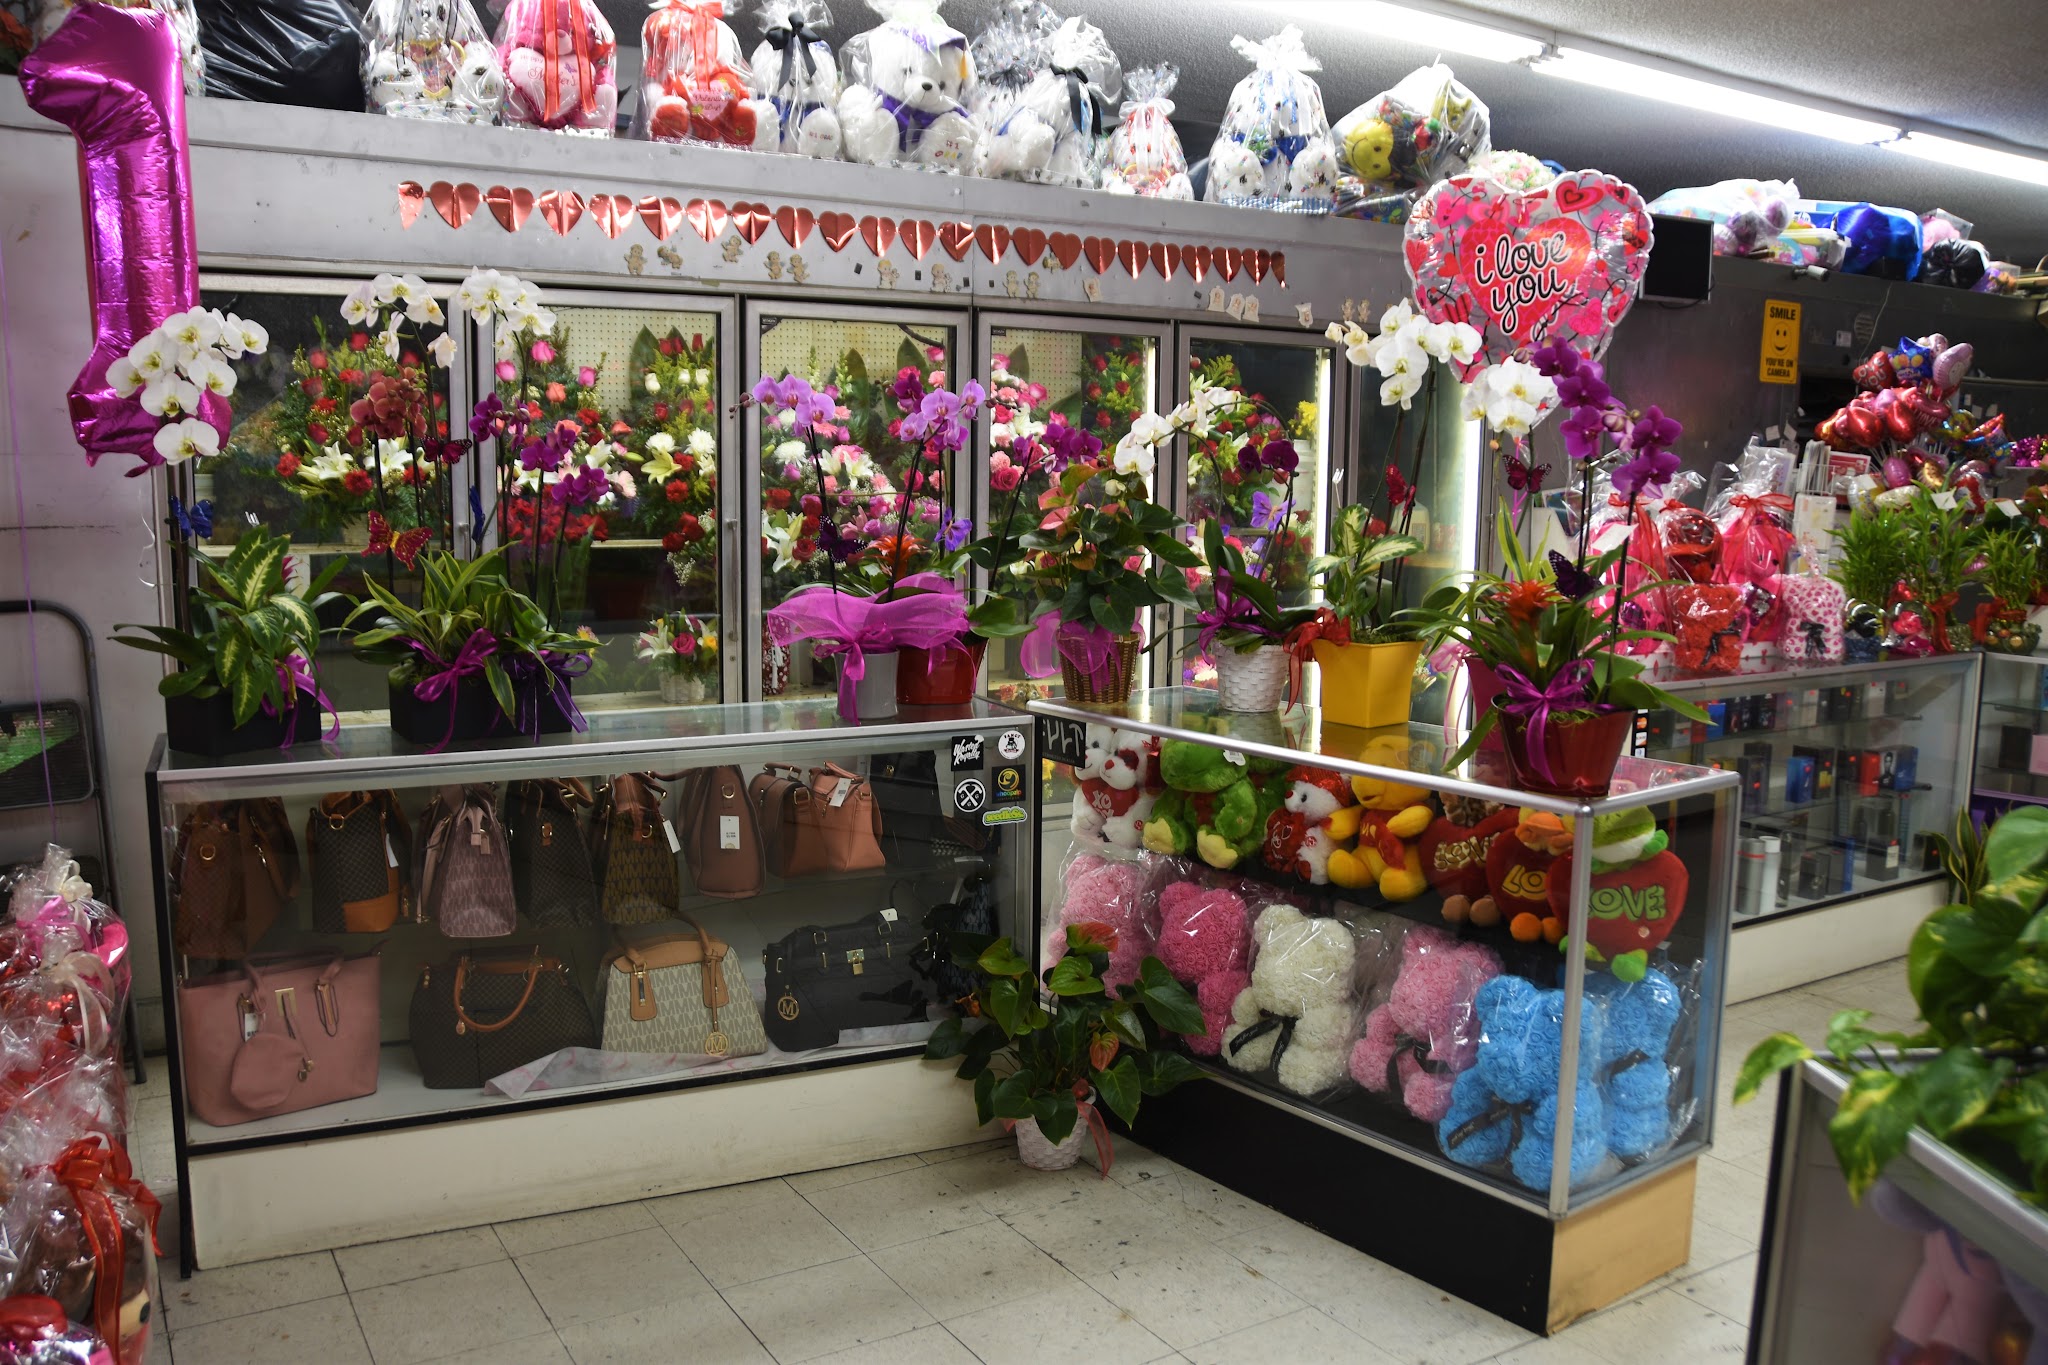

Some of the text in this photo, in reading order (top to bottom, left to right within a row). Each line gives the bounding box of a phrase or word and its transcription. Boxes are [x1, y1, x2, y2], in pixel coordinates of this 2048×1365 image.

[1476, 232, 1570, 285] i love
[1491, 267, 1567, 334] you
[1769, 306, 1796, 321] SMILE
[1765, 357, 1794, 368] YOU'RE ON
[1766, 367, 1791, 378] CAMERA
[1853, 357, 1884, 384] LOVE
[1861, 368, 1887, 387] YOU
[1502, 864, 1547, 901] LO
[1588, 885, 1667, 922] OVE
